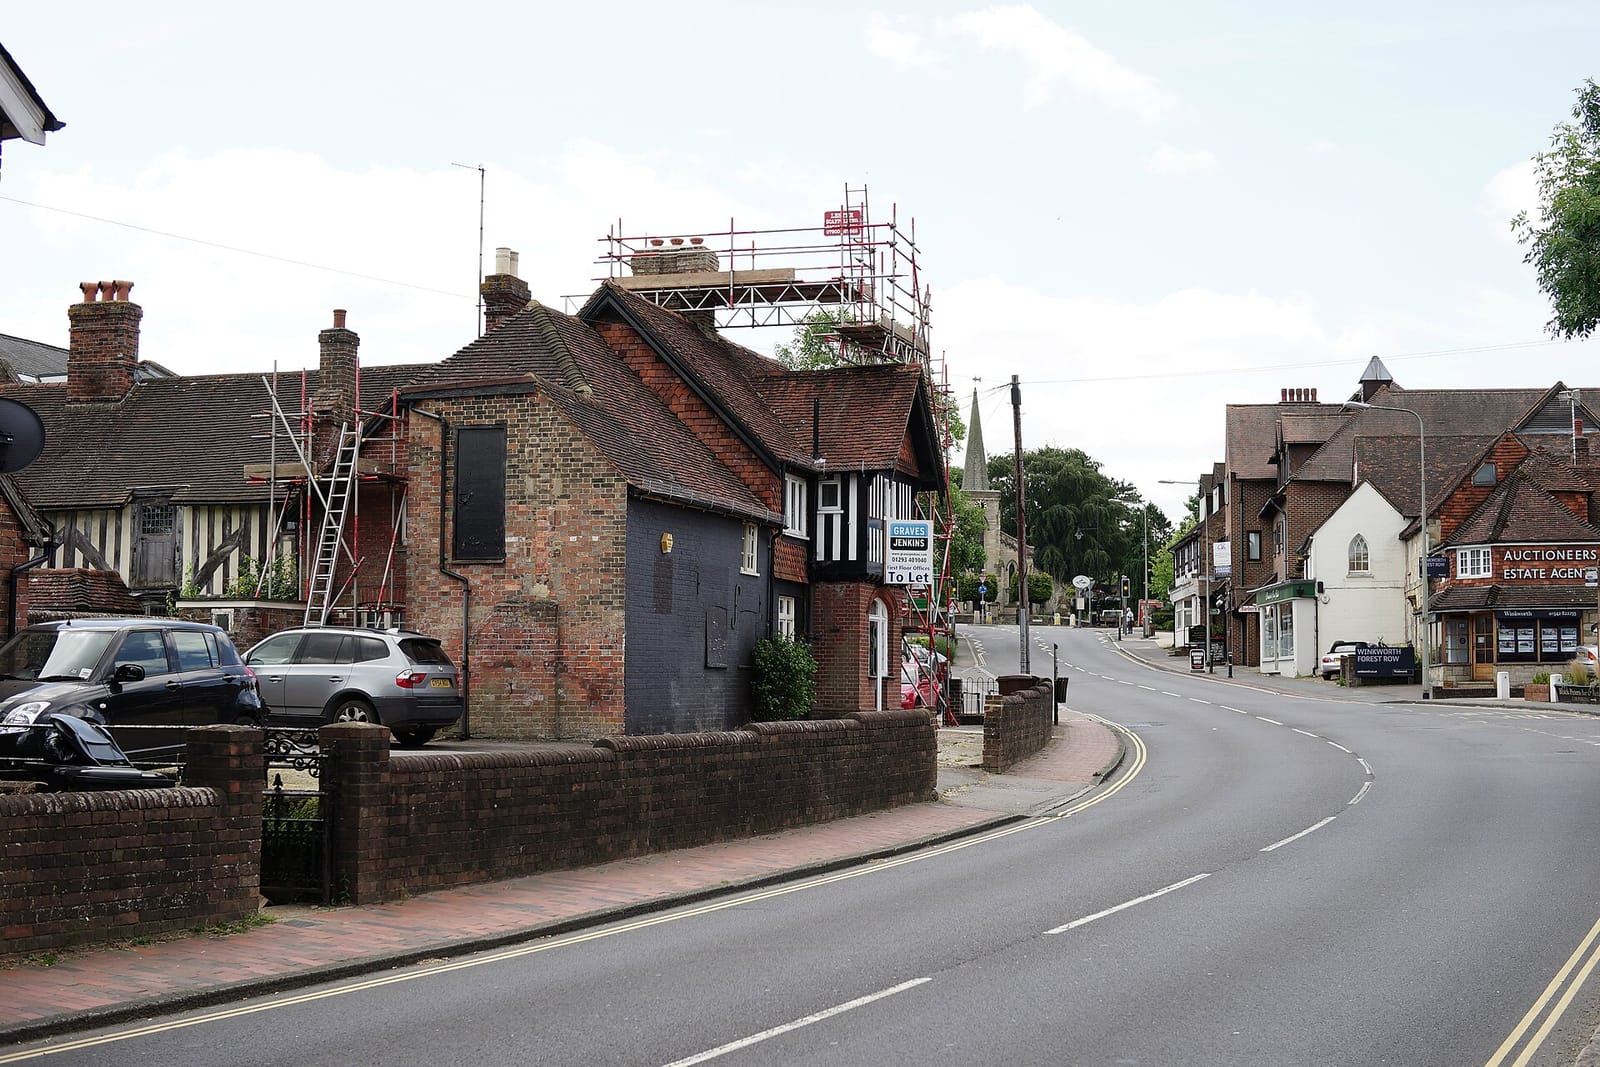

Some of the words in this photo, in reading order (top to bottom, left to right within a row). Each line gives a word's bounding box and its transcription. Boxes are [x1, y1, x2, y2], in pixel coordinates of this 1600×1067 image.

[894, 527, 925, 535] GRAVES
[893, 539, 925, 547] JENKINS
[1504, 550, 1597, 561] AUCTIONEERS
[888, 571, 904, 582] To
[908, 571, 929, 582] Let
[1503, 568, 1546, 579] ESTATE
